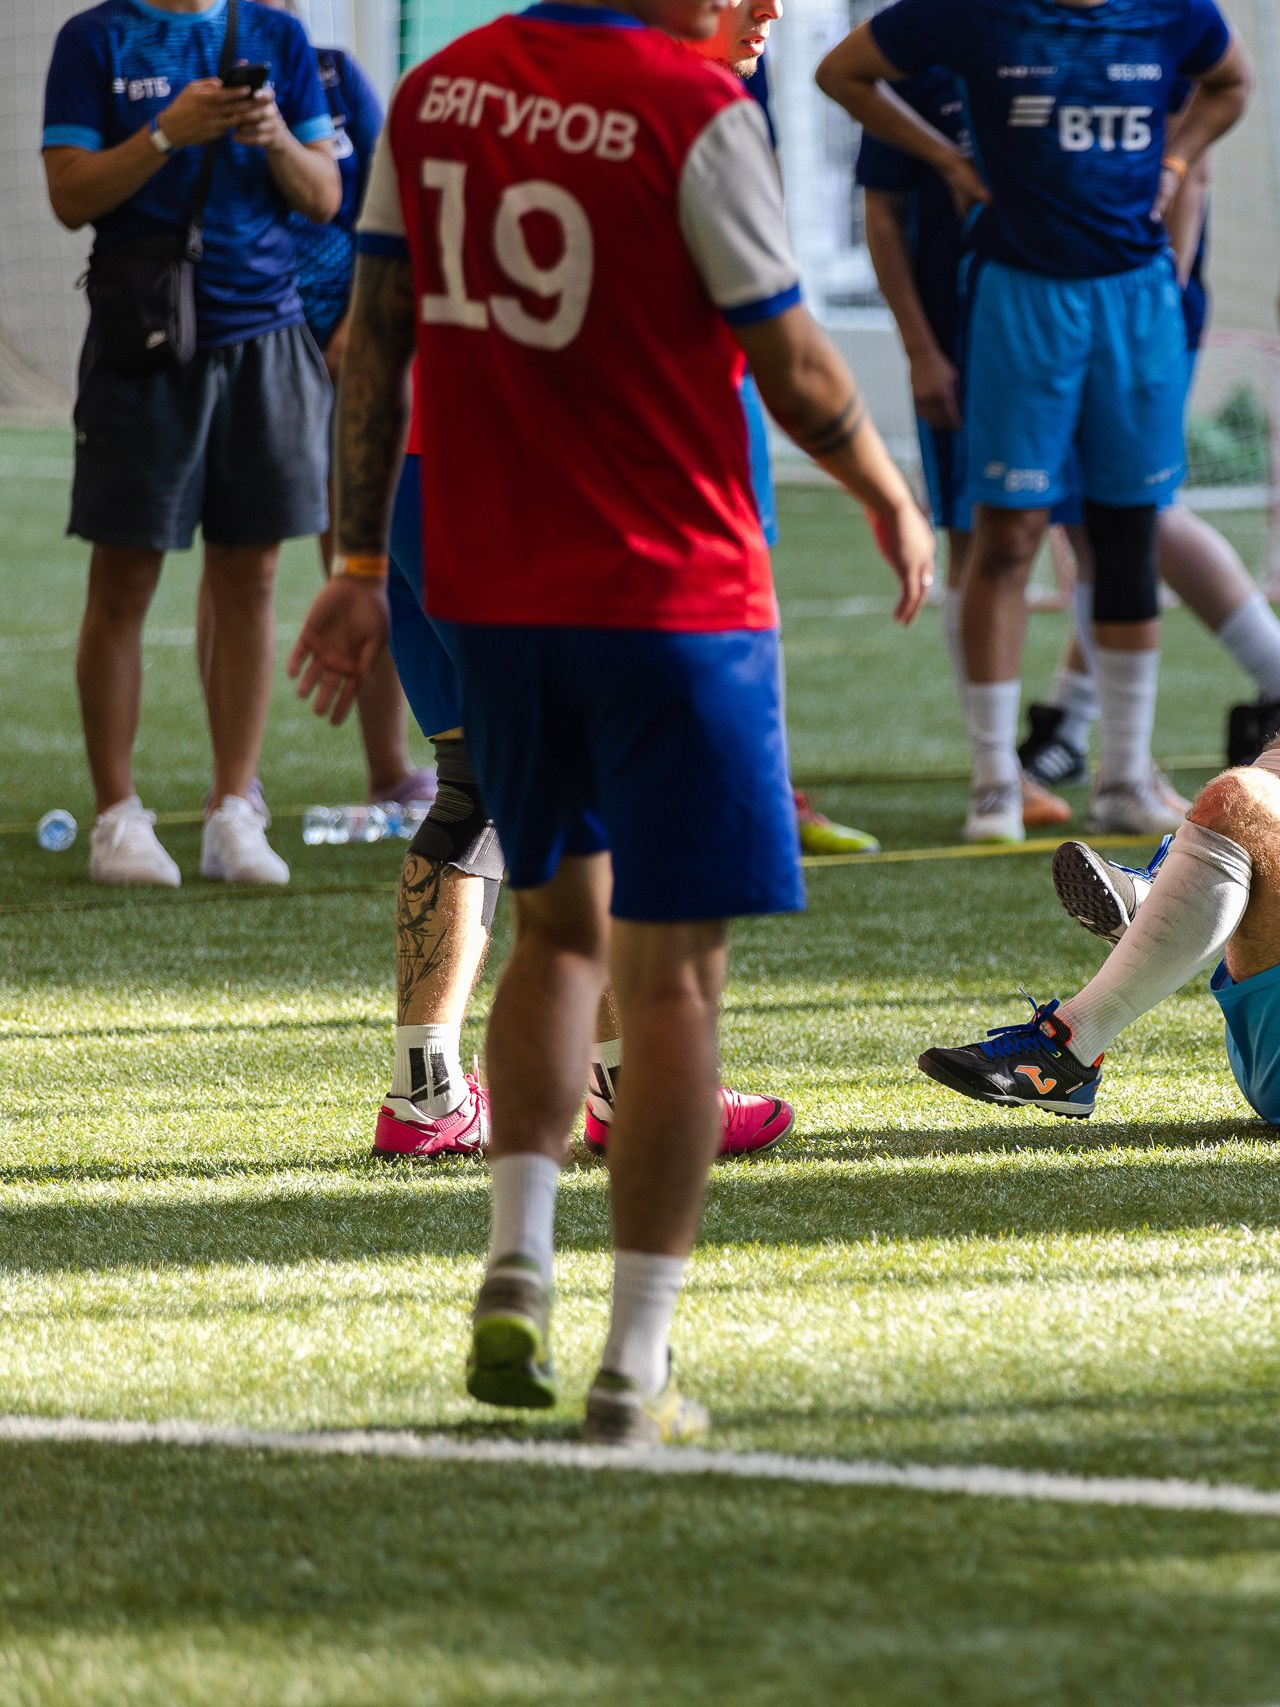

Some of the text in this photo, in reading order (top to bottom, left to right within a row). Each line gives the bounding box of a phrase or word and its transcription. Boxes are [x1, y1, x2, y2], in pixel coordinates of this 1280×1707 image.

[127, 76, 171, 101] ВТБ
[418, 75, 639, 161] БЯГУРОВ
[1058, 105, 1153, 152] ВТБ
[421, 157, 594, 351] 19
